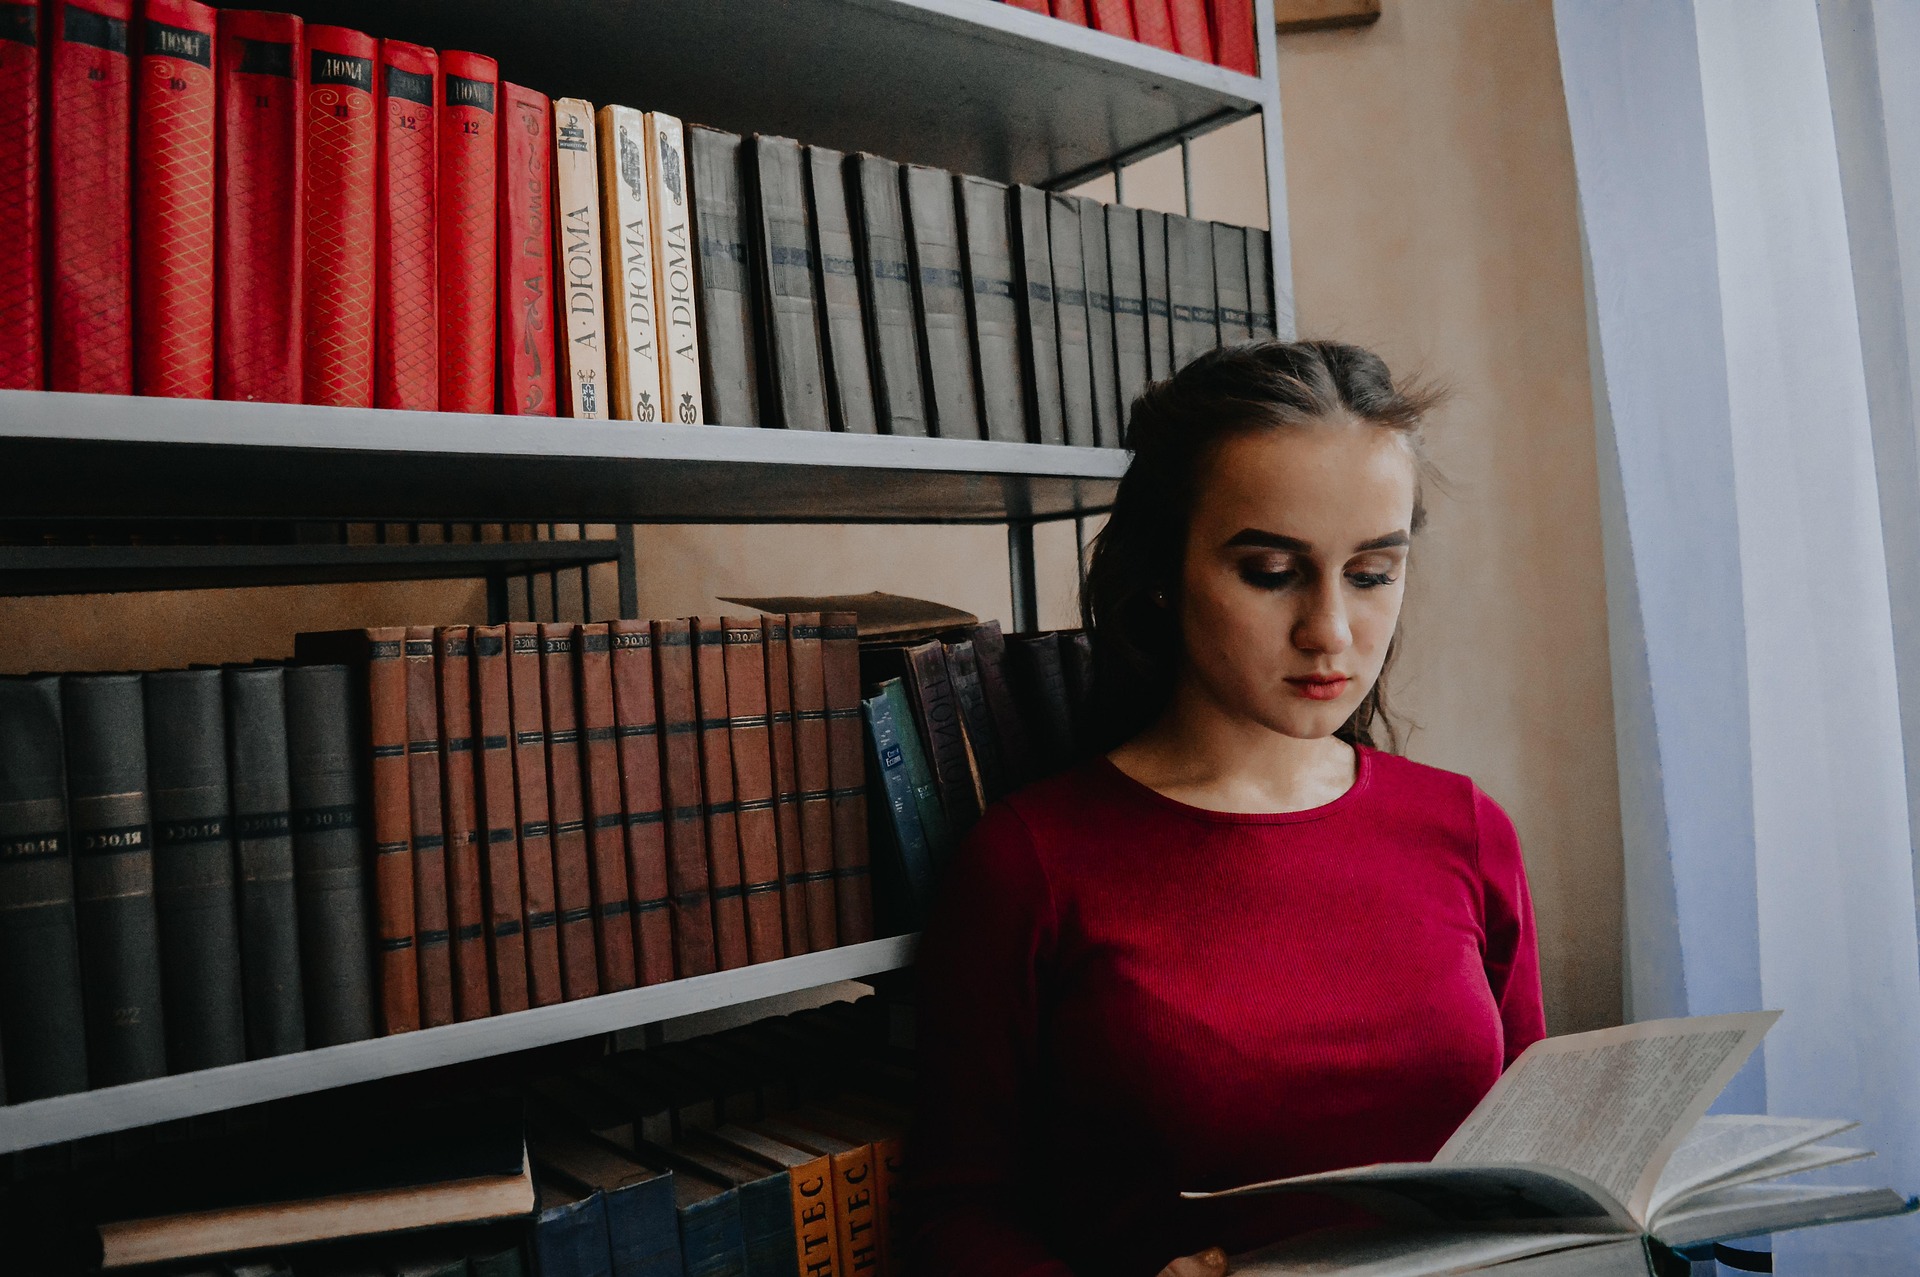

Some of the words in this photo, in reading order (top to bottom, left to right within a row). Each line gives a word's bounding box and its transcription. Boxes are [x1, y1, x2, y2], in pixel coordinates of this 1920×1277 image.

[322, 58, 363, 81] ДЮМА
[399, 116, 416, 130] 12
[463, 121, 480, 135] 12
[843, 1164, 877, 1277] НТЕС
